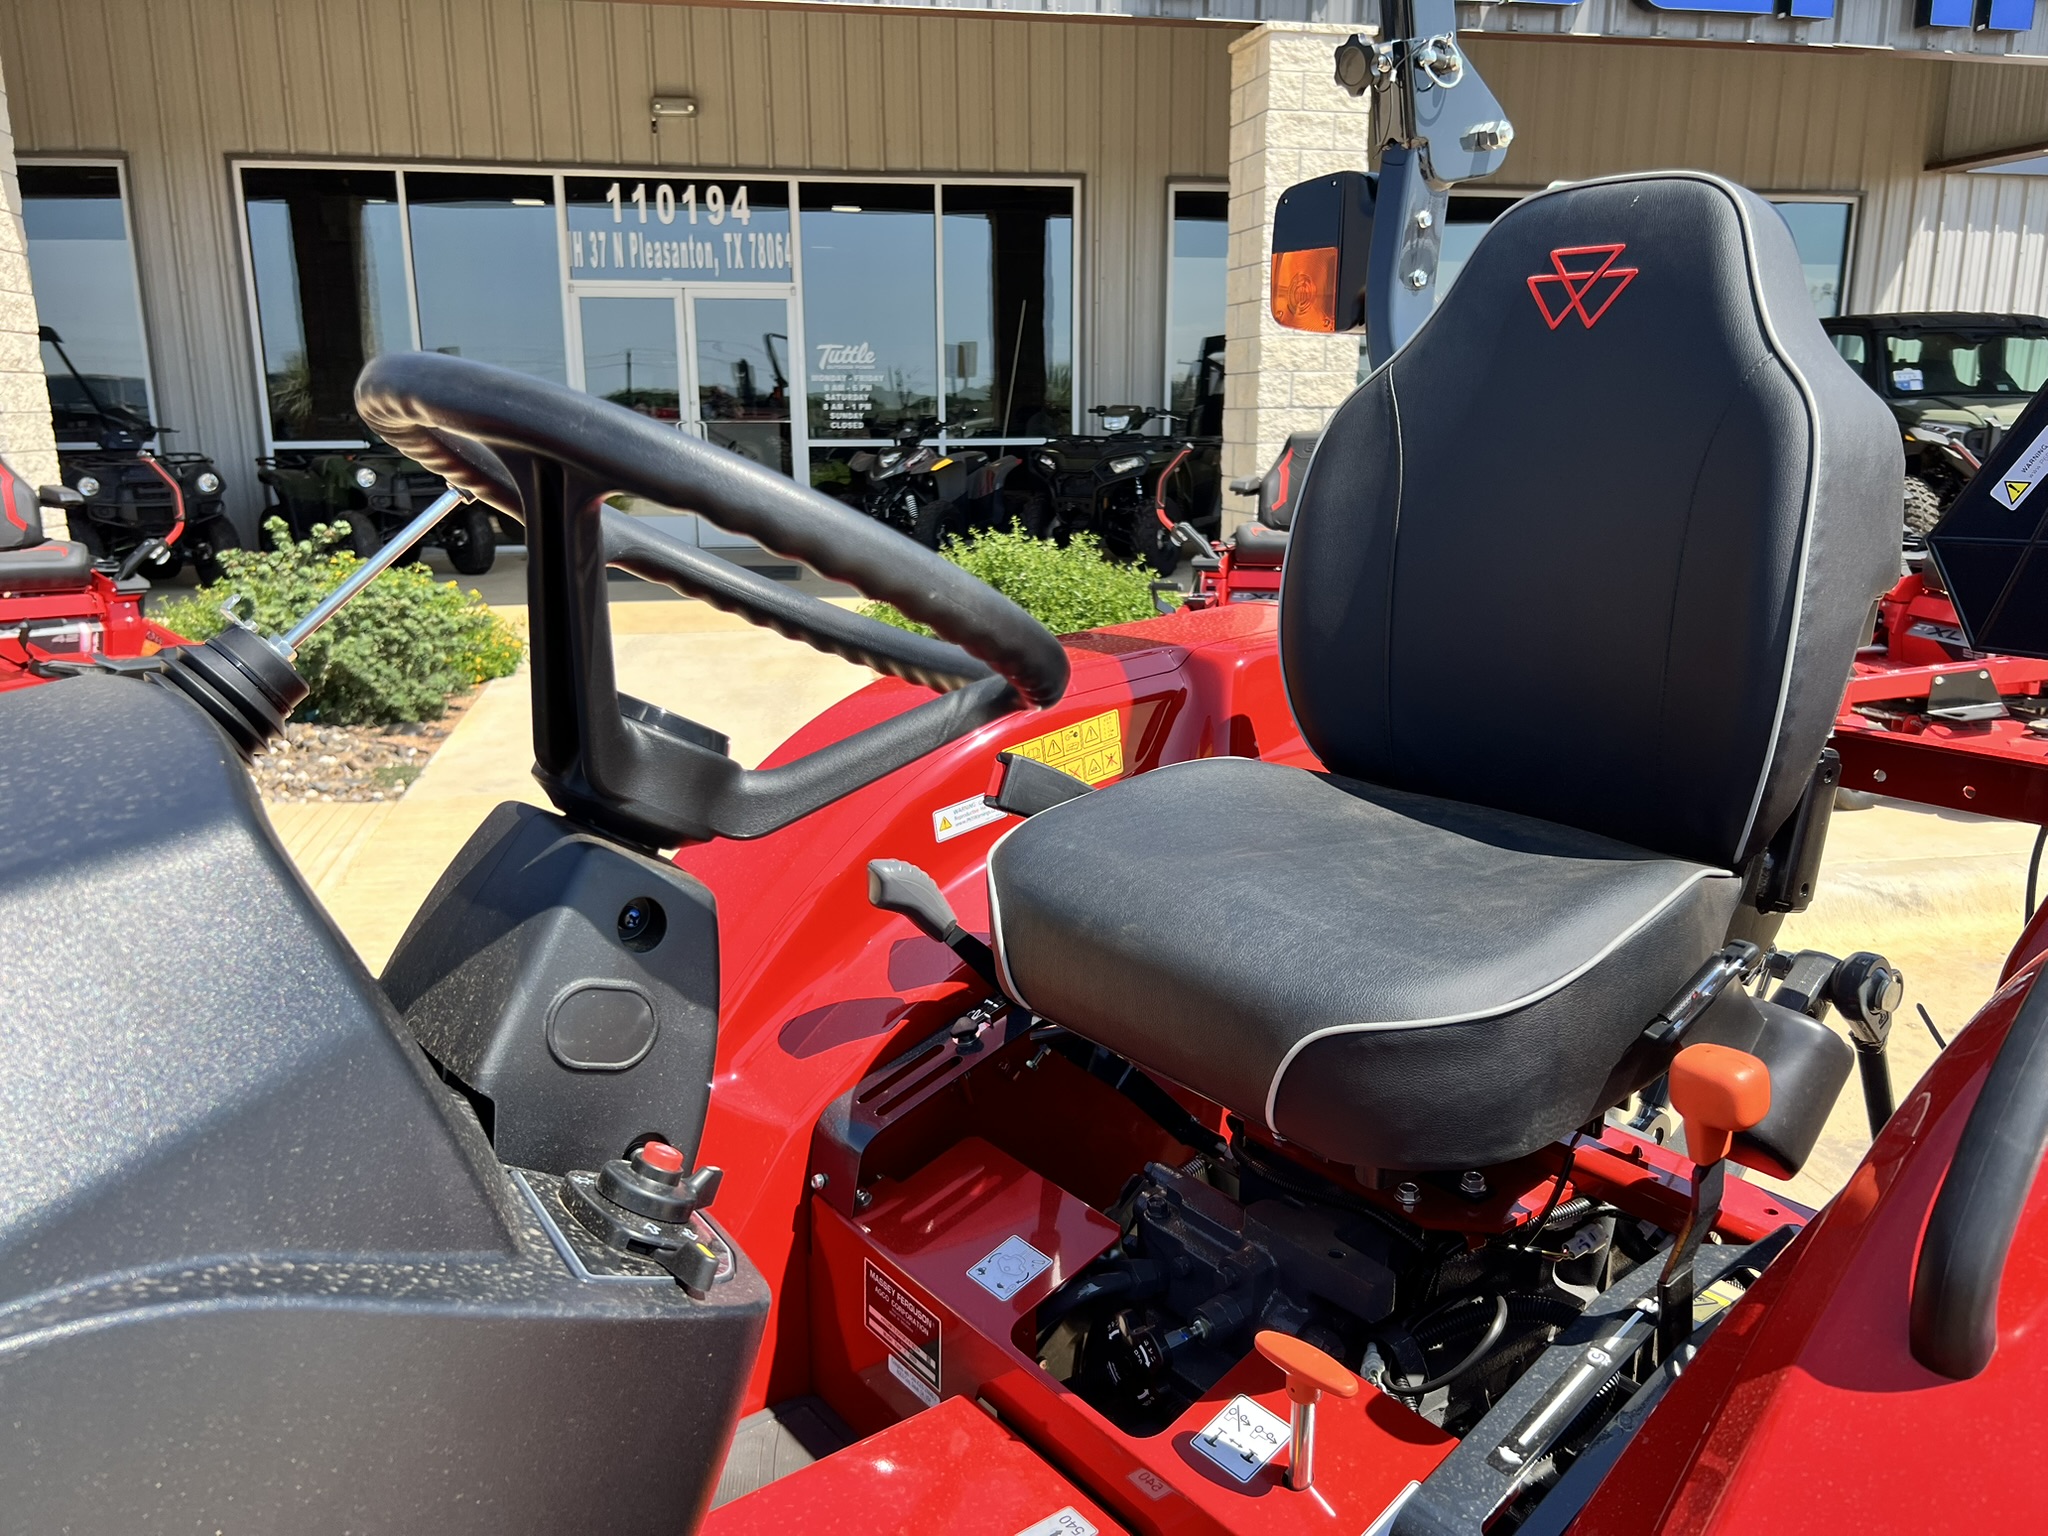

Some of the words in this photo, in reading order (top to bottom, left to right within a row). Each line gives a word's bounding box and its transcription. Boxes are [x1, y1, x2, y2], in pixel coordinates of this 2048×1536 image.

[606, 182, 751, 226] 110194
[589, 231, 606, 268] 37
[613, 231, 625, 268] N
[629, 231, 719, 277] Pleasanton,
[723, 232, 744, 269] TX
[816, 341, 876, 370] Tuttle
[824, 393, 870, 401] SATURDAY
[829, 412, 865, 420] SUNDAY
[830, 421, 865, 430] CLOSED
[869, 1269, 896, 1296] MASSEY
[897, 1292, 932, 1328] FERGUSON
[1059, 1515, 1085, 1536] 540
